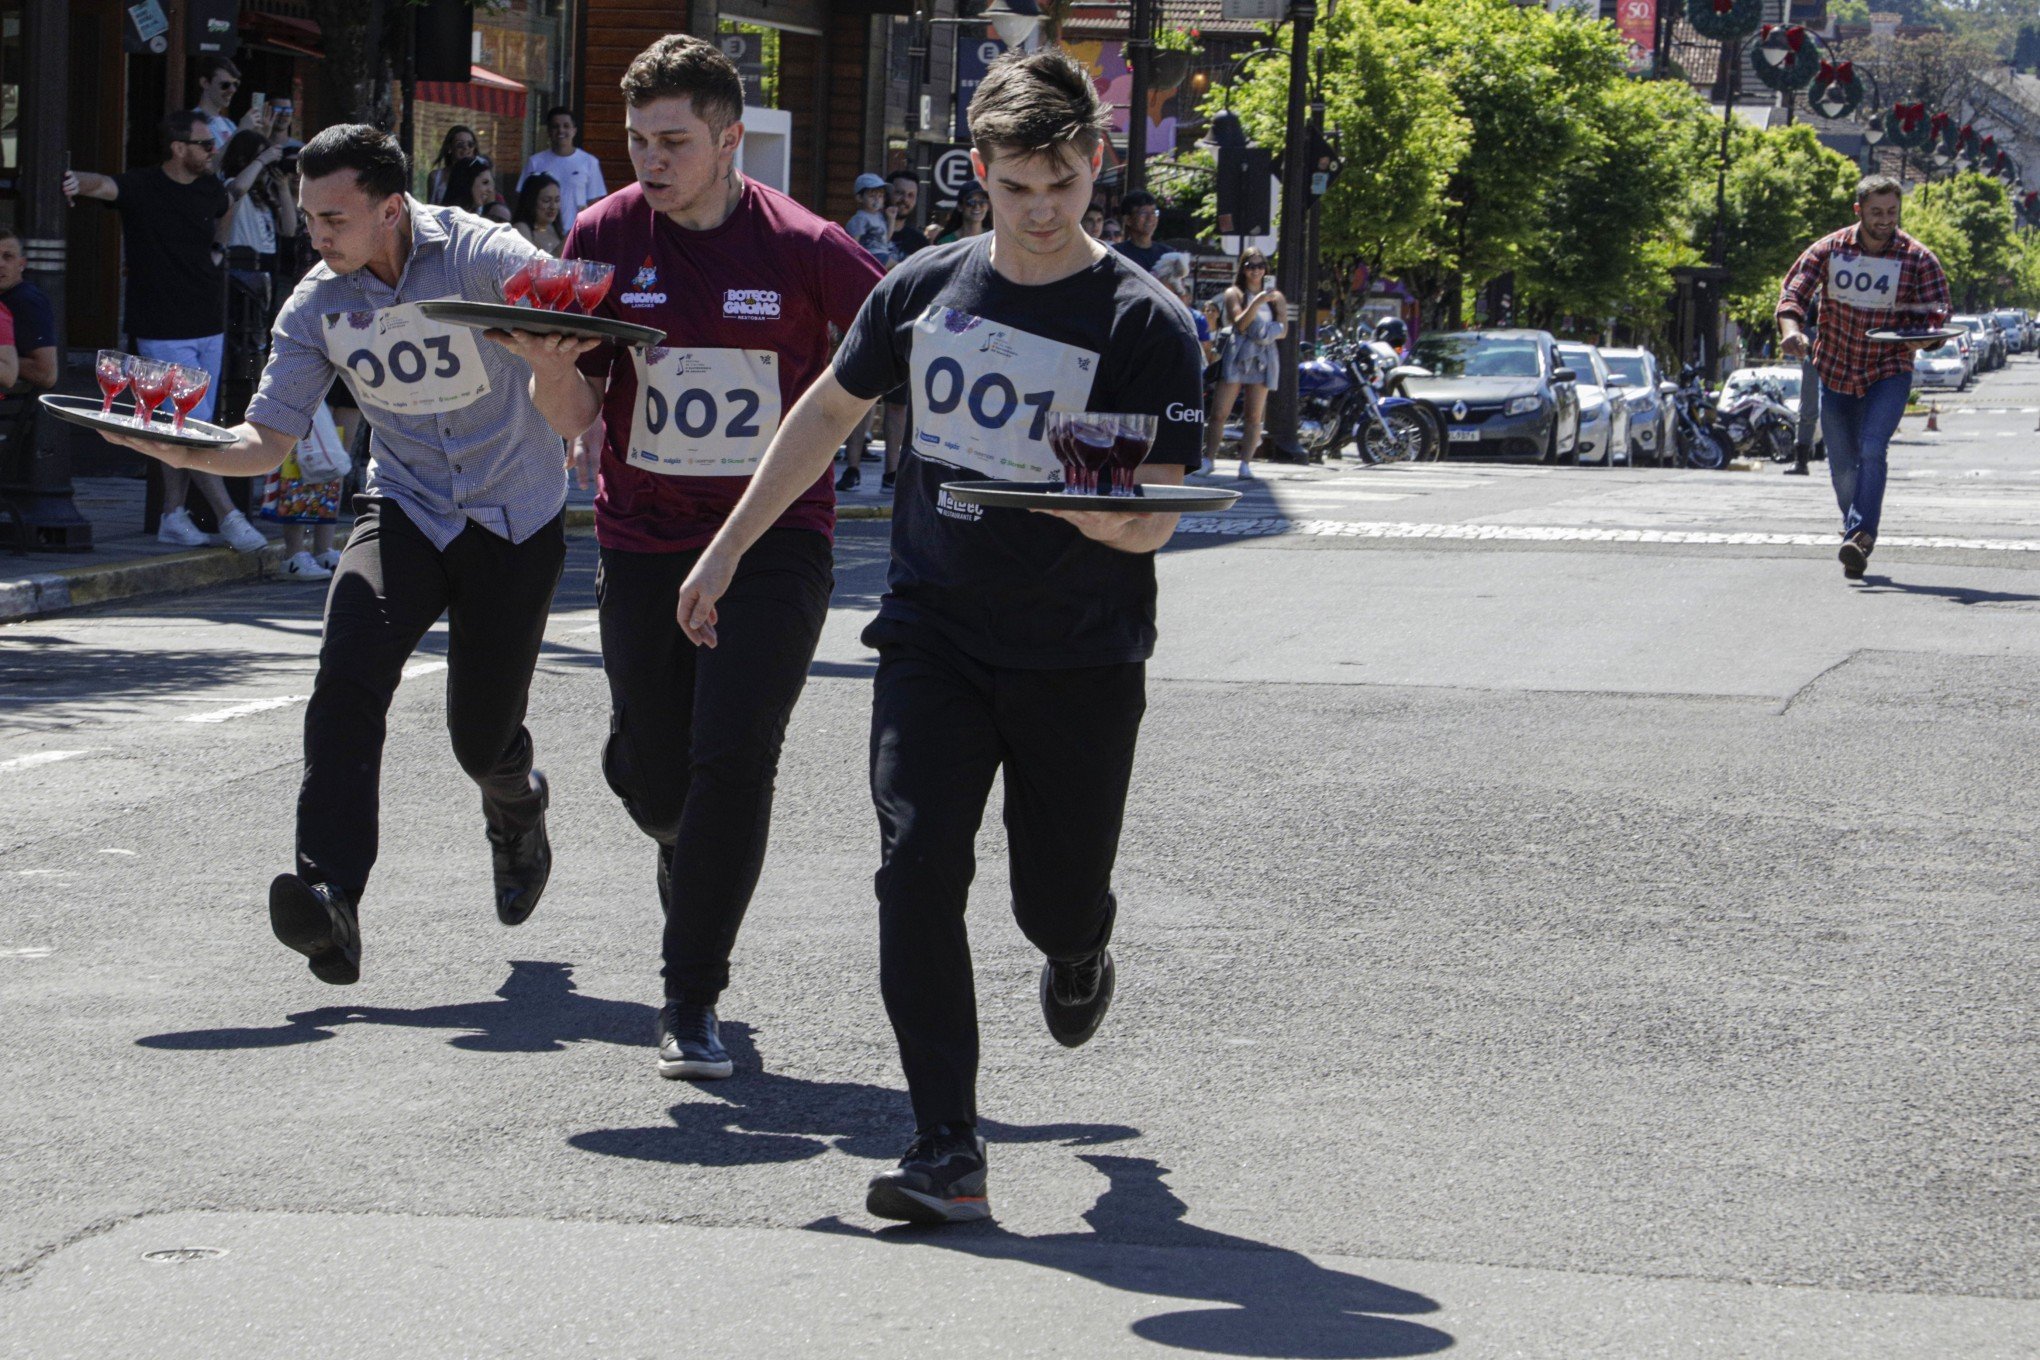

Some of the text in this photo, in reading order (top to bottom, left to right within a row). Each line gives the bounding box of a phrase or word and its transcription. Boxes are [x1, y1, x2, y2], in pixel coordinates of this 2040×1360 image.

[1628, 1, 1649, 19] 50
[983, 46, 995, 59] E
[947, 159, 969, 186] E
[1834, 269, 1890, 294] 004
[621, 292, 667, 304] GNOMO
[727, 289, 778, 302] BOTECO
[723, 301, 781, 316] GNOMO
[346, 335, 461, 388] 003
[925, 356, 1055, 441] 001
[645, 385, 760, 438] 002
[1165, 402, 1204, 424] Gen
